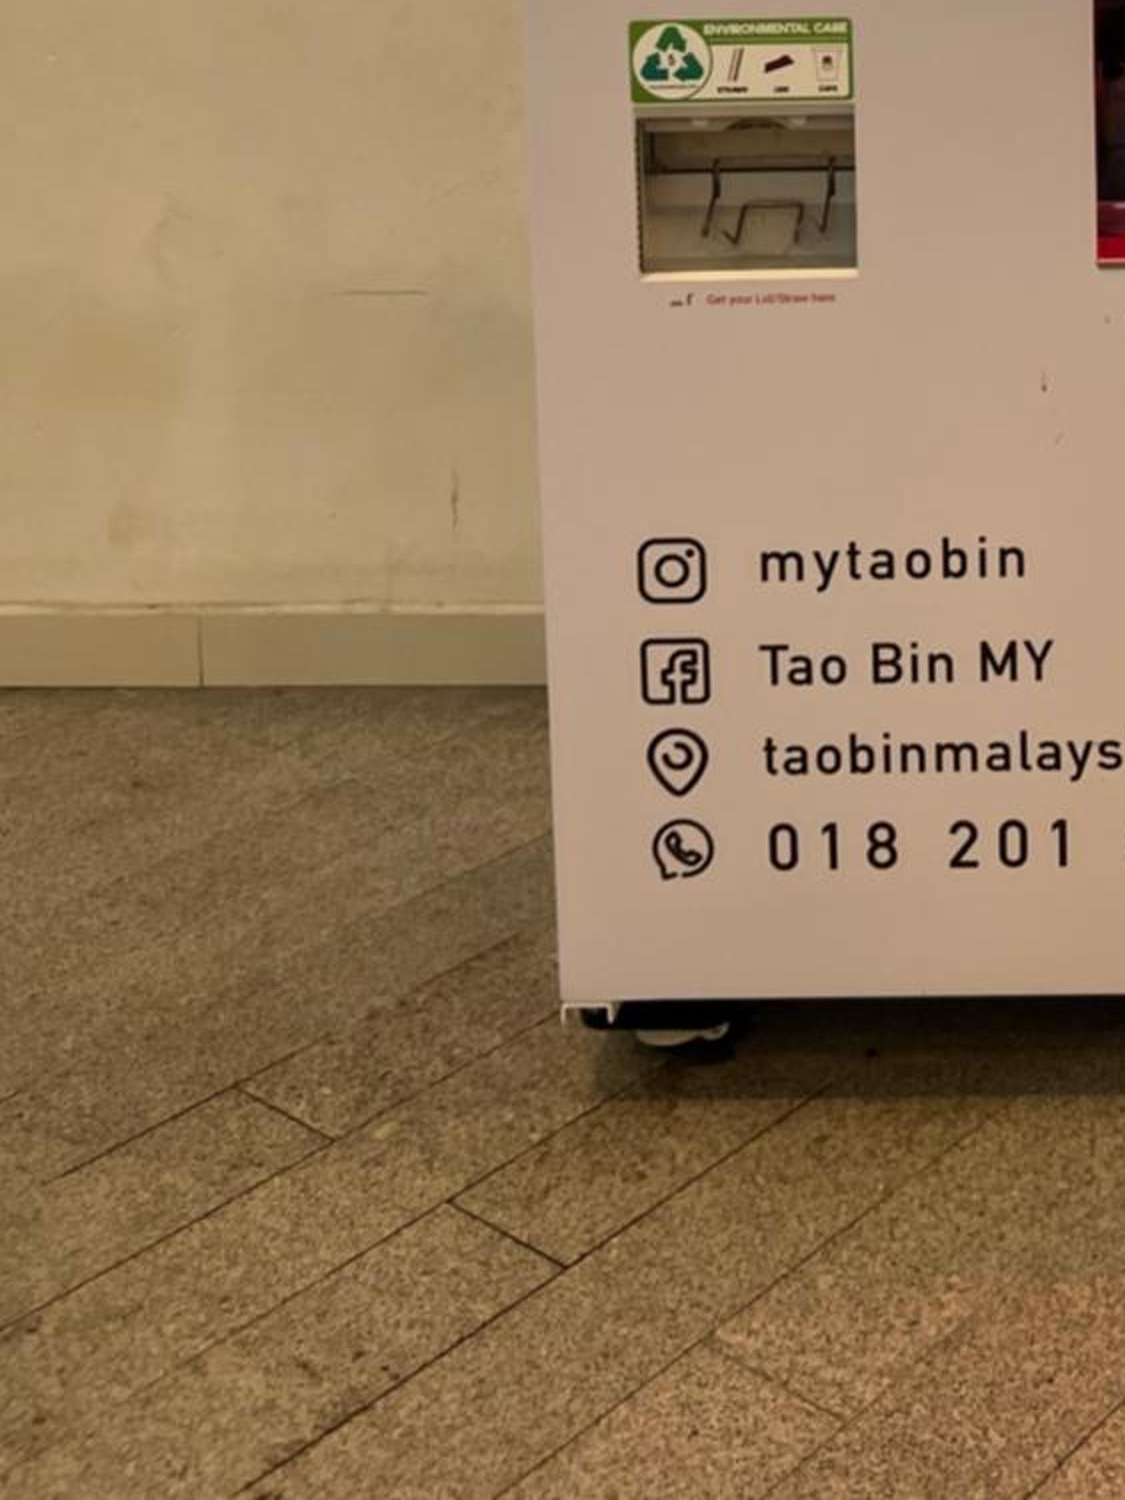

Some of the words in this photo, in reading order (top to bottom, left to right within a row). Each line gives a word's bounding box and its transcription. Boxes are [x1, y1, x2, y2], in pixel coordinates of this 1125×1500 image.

[703, 22, 811, 35] ENVIRONMENTAL
[813, 20, 849, 34] CARE
[706, 292, 726, 306] Get
[759, 536, 1026, 592] mytaobin
[758, 644, 848, 686] Tao
[870, 641, 954, 684] Bin
[979, 639, 1054, 682] MY
[767, 820, 899, 871] 018
[948, 819, 1070, 870] 201
